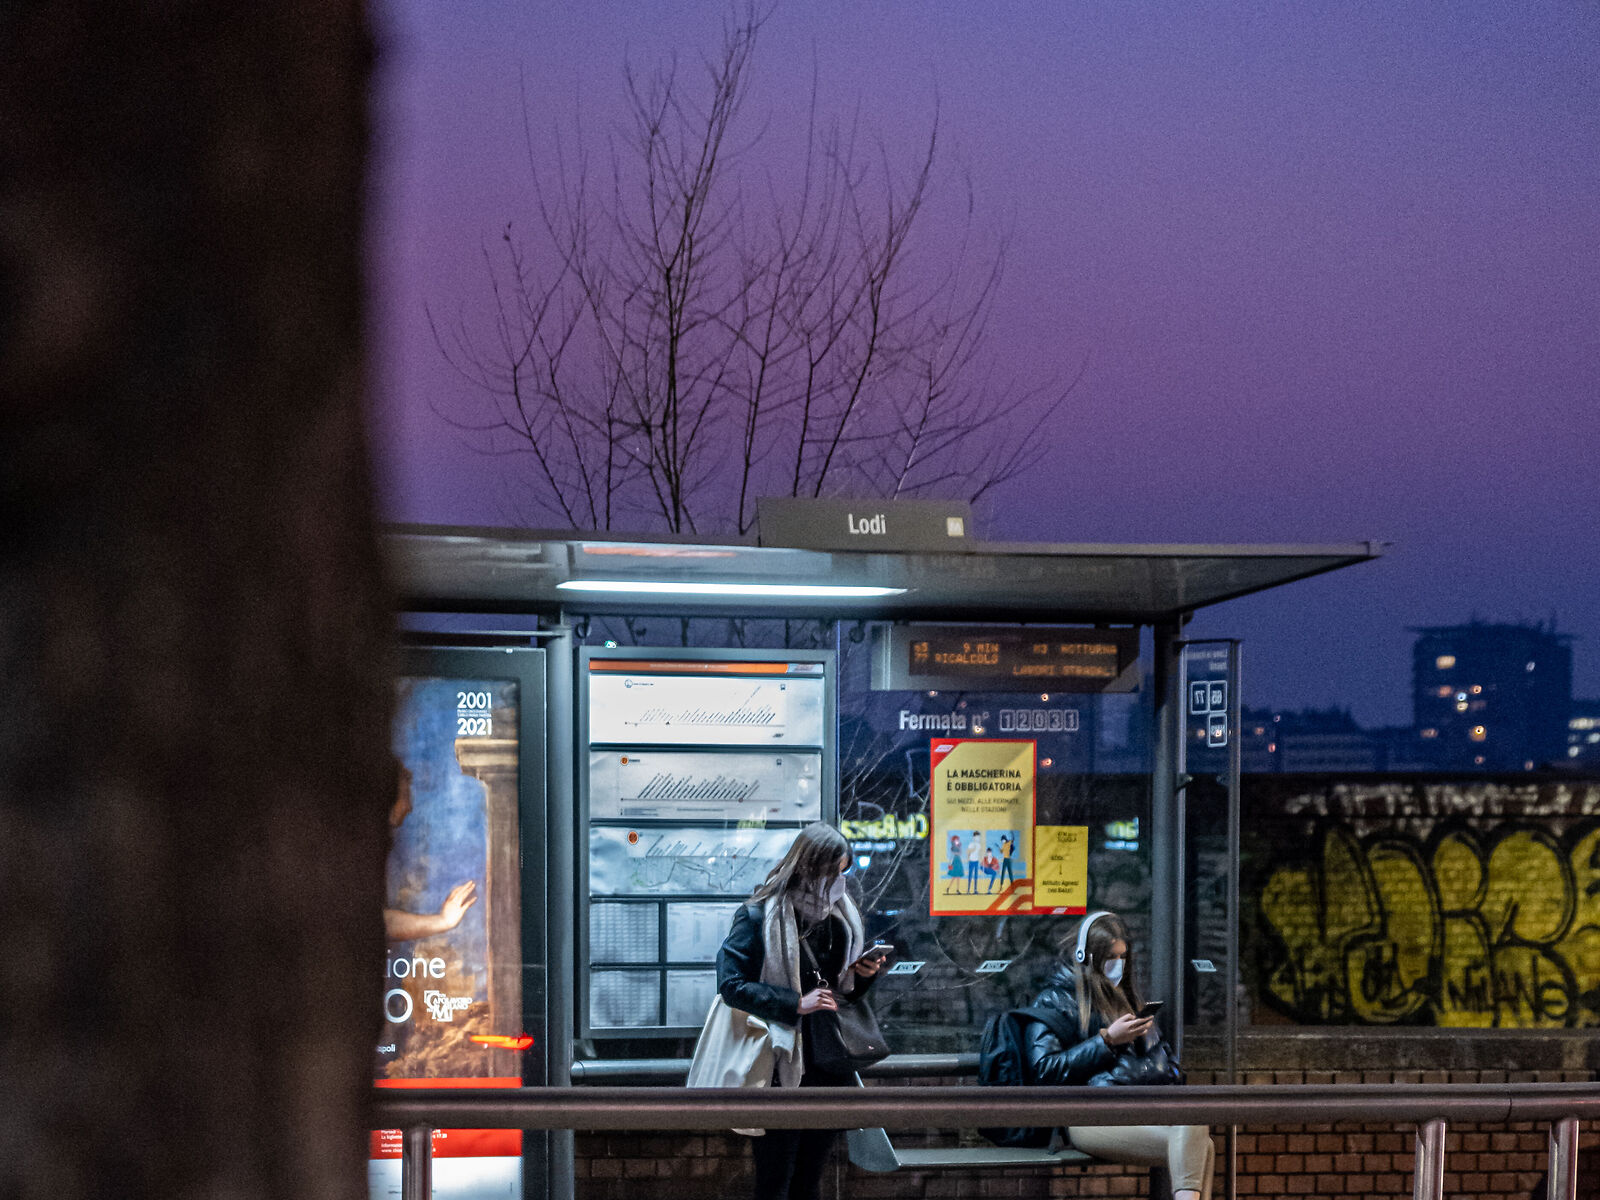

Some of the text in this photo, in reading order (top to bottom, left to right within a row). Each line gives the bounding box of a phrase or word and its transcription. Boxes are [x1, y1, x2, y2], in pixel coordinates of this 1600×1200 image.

[848, 513, 886, 534] Lodi
[457, 691, 492, 709] 2001
[457, 717, 493, 735] 2021
[900, 710, 967, 730] Fermata
[1002, 711, 1077, 730] 12031
[946, 769, 1022, 779] LA MASCHERINA
[955, 782, 1022, 792] OBBLIGATORIA
